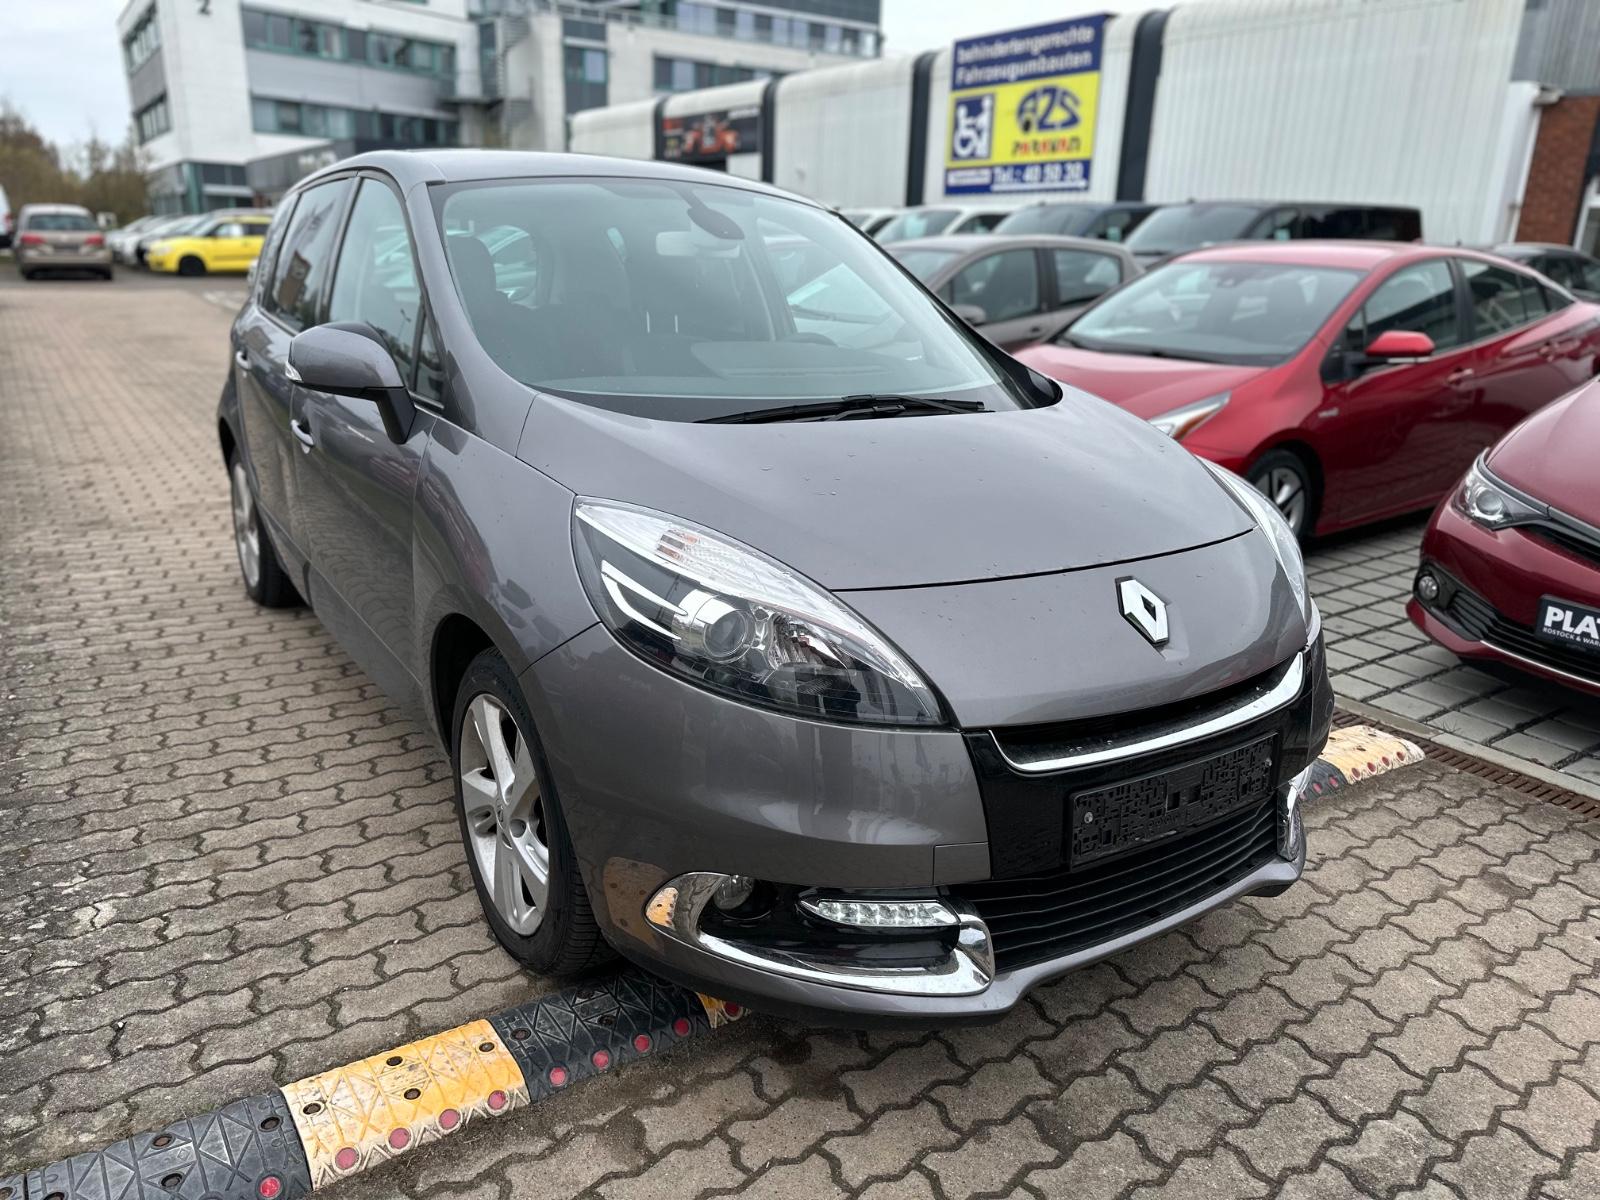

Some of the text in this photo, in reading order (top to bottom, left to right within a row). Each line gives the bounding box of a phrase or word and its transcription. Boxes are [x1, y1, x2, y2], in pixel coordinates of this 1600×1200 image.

[957, 26, 1095, 63] behindertengerechte
[955, 51, 1092, 84] Fahrzeugumbauten
[1543, 627, 1575, 640] ROSTOCK
[1544, 606, 1600, 639] PLA
